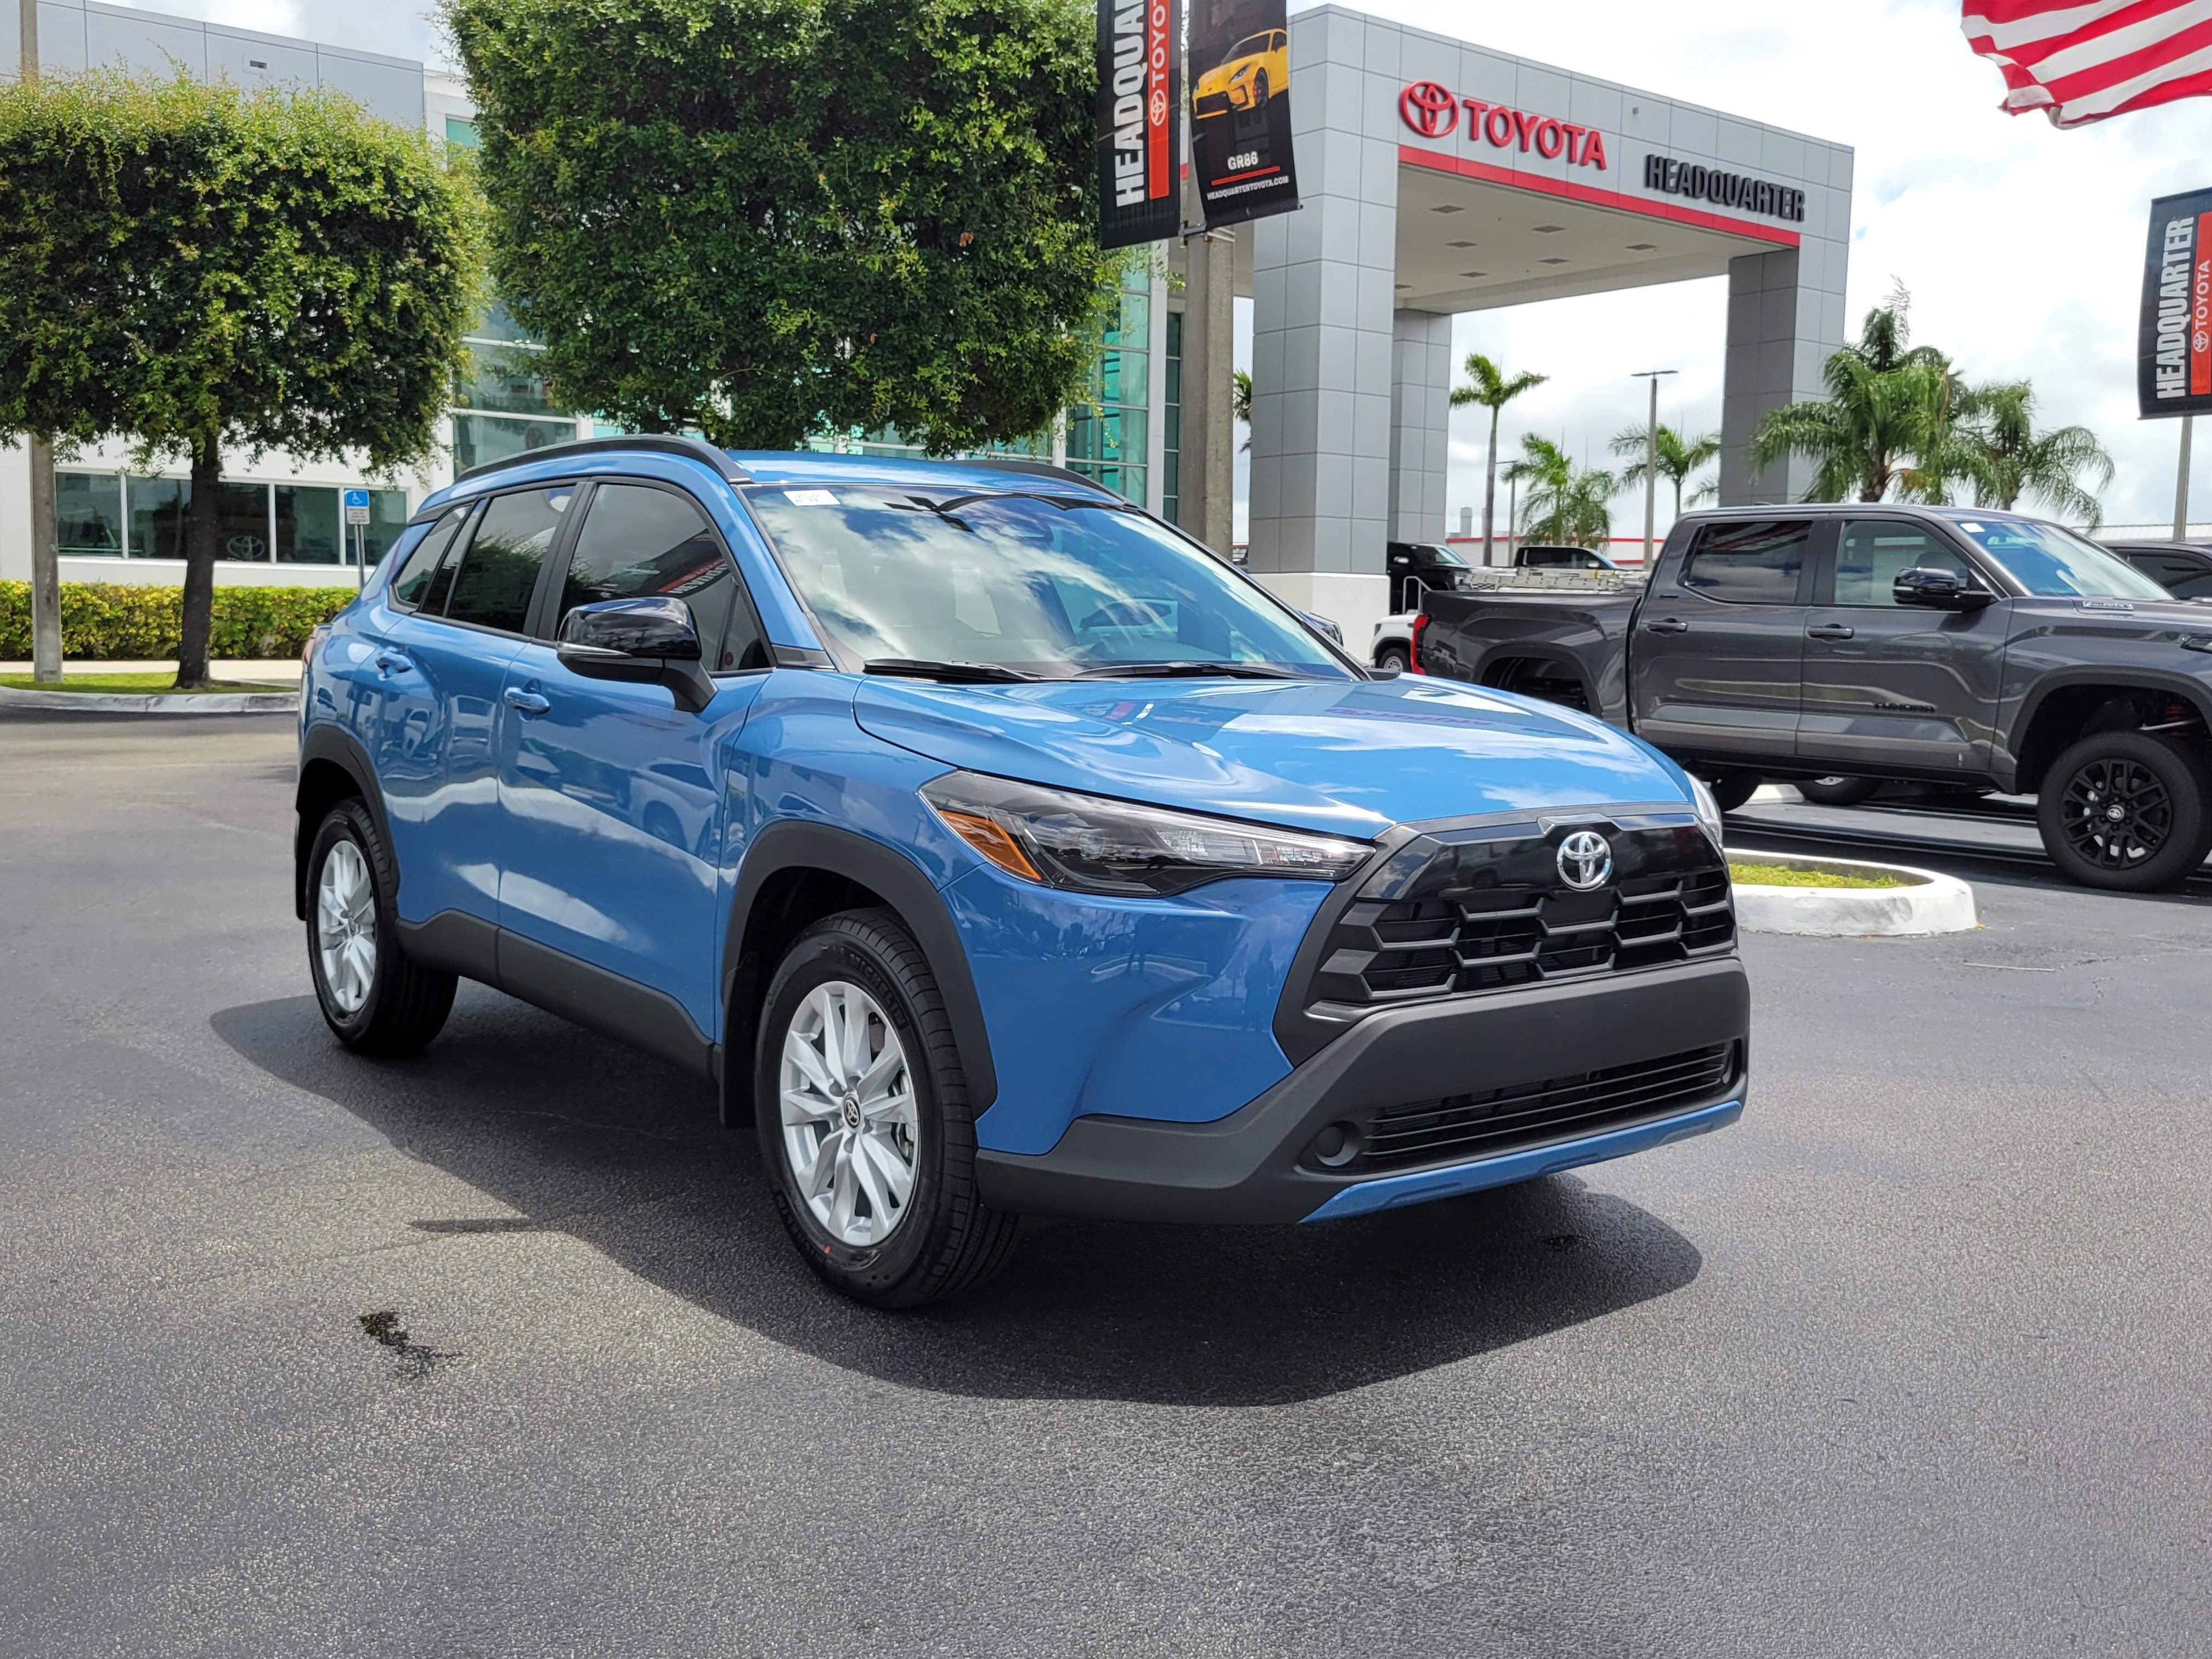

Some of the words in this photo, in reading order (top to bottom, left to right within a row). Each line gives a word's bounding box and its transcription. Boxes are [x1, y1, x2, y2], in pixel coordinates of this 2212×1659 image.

[1227, 151, 1259, 171] GR86
[1463, 98, 1608, 170] TOYOTA
[1207, 175, 1289, 201] HEADQUARTERTOYOTA.COM
[1645, 154, 1805, 222] HEADQUARTER
[2156, 216, 2194, 399] HEADQUARTER
[2194, 259, 2210, 329] TOYOTA
